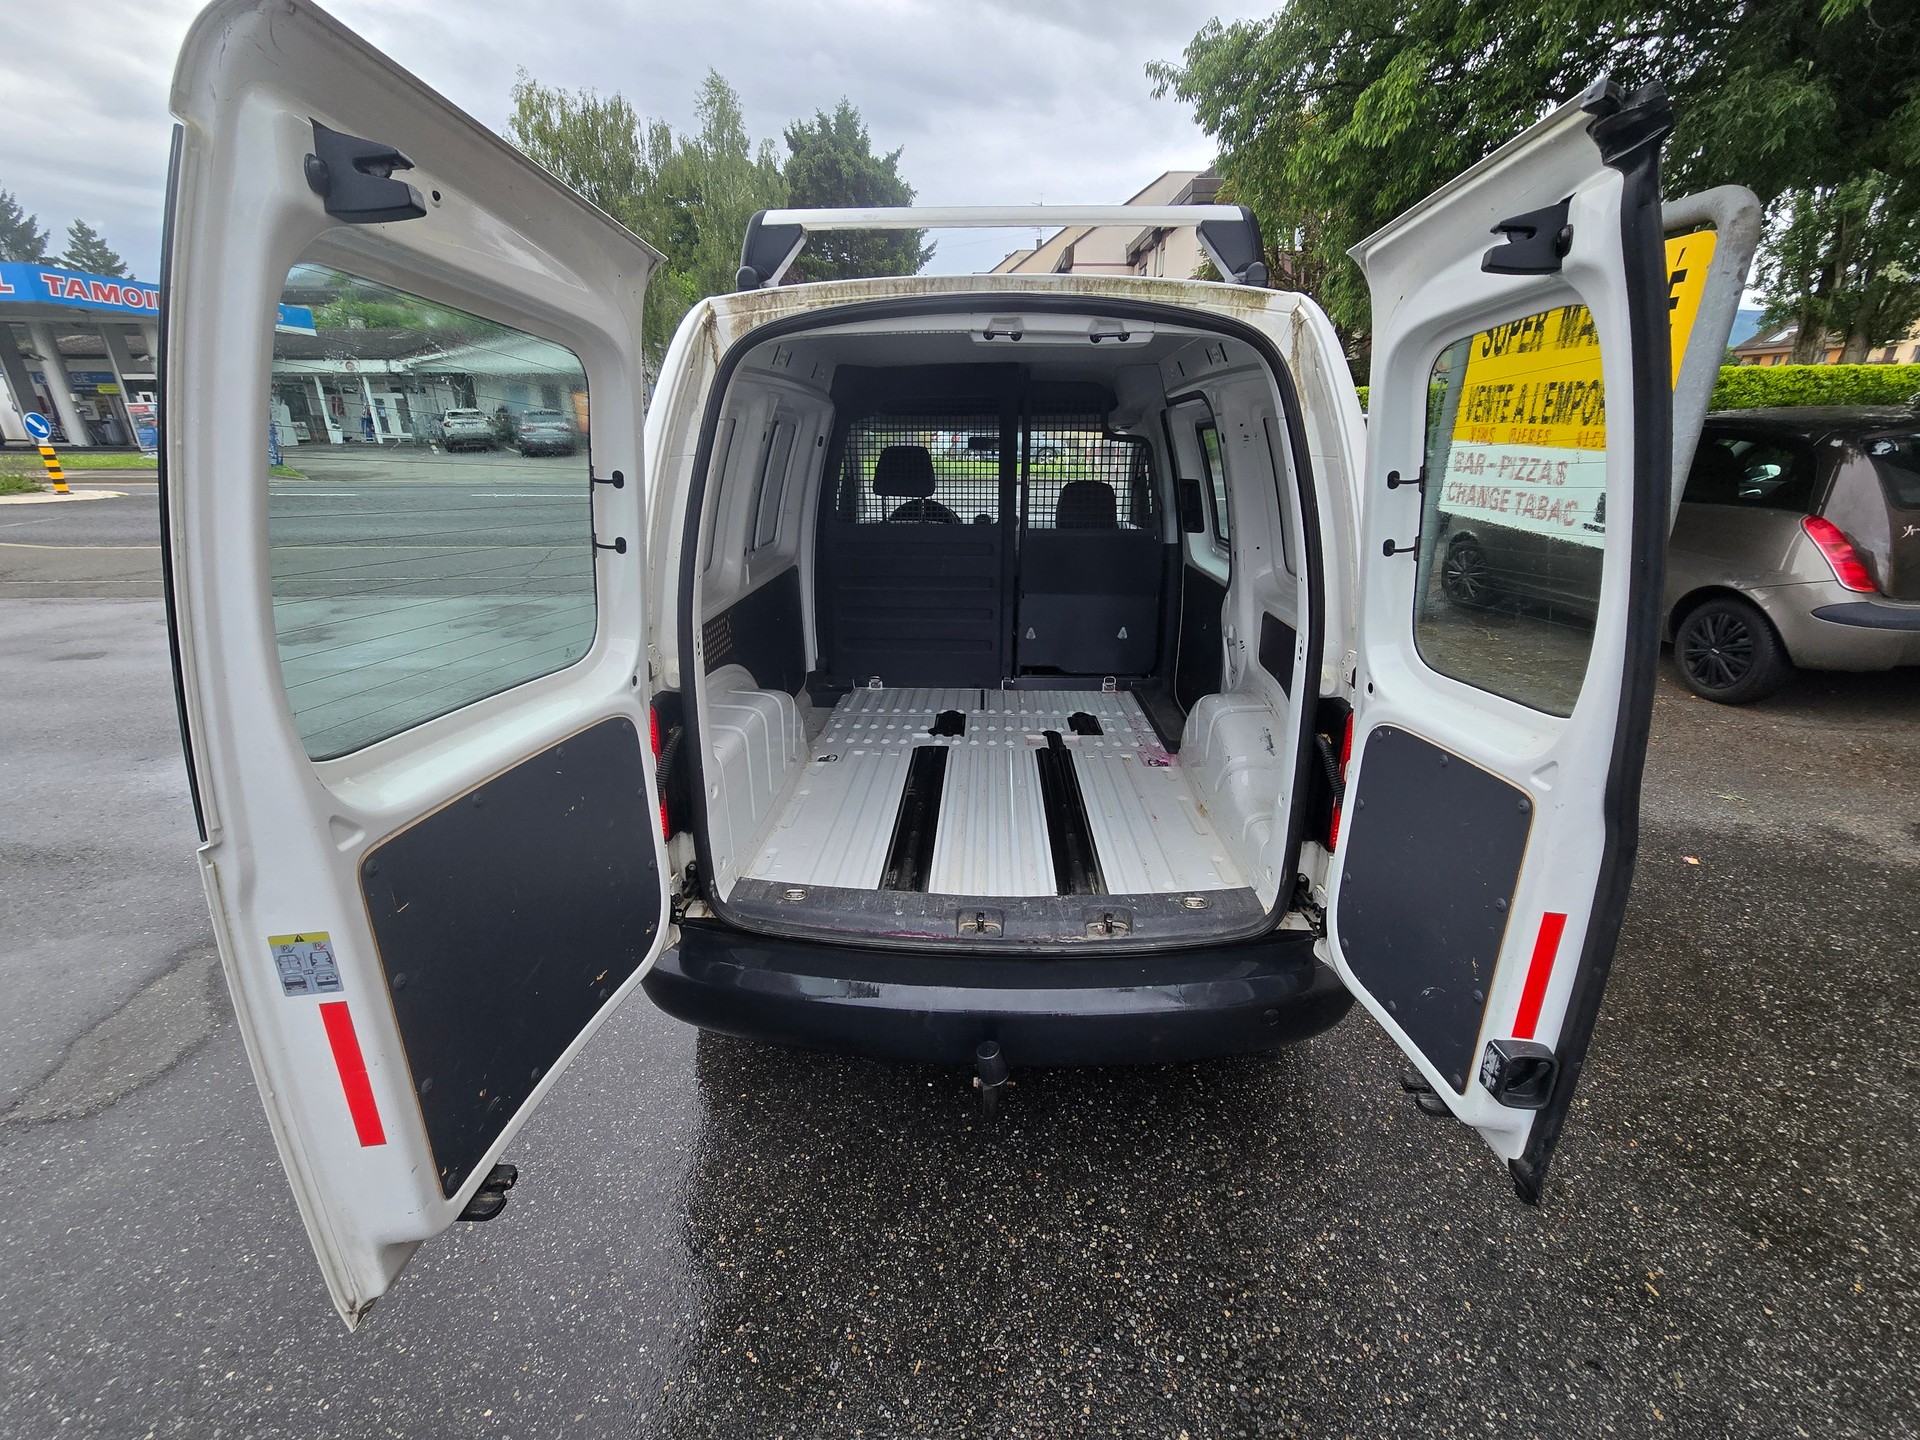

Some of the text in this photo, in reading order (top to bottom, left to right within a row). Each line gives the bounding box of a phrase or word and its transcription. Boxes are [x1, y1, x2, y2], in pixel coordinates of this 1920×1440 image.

[1466, 384, 1514, 424] VENTE
[1446, 481, 1579, 527] CHANGE TABAC
